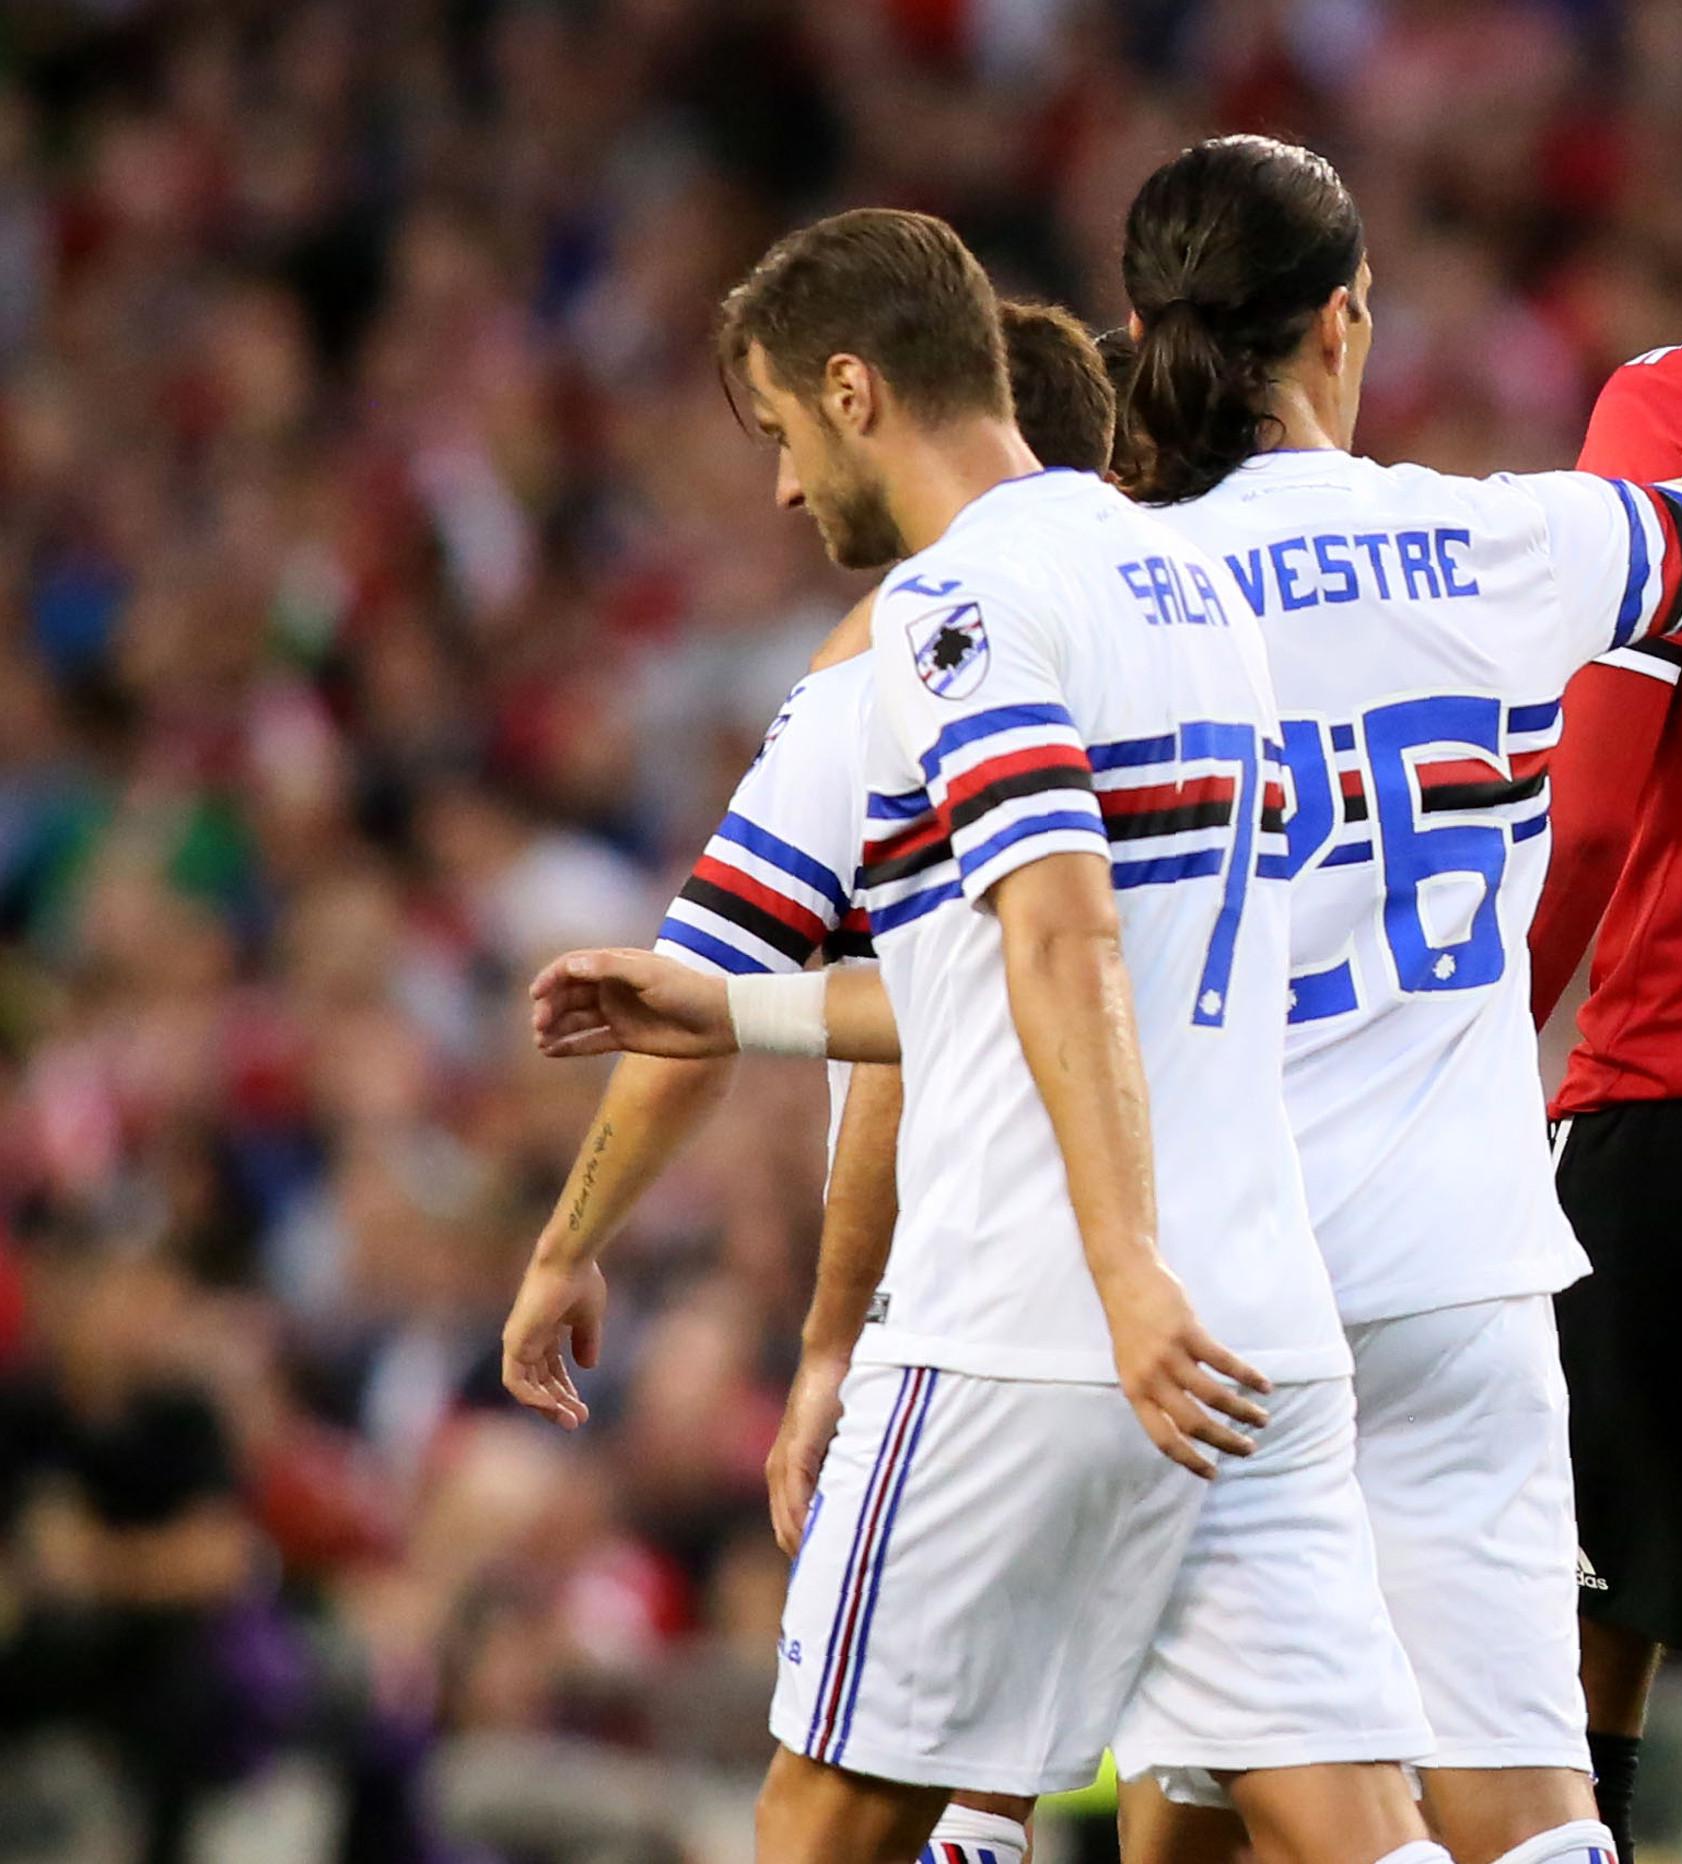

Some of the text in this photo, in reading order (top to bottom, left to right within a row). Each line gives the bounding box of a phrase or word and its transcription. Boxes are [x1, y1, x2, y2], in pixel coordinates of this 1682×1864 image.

[1116, 555, 1229, 626] SALA
[1223, 528, 1480, 617] VESTRE
[1176, 718, 1260, 1029] 7
[1576, 1569, 1609, 1590] das
